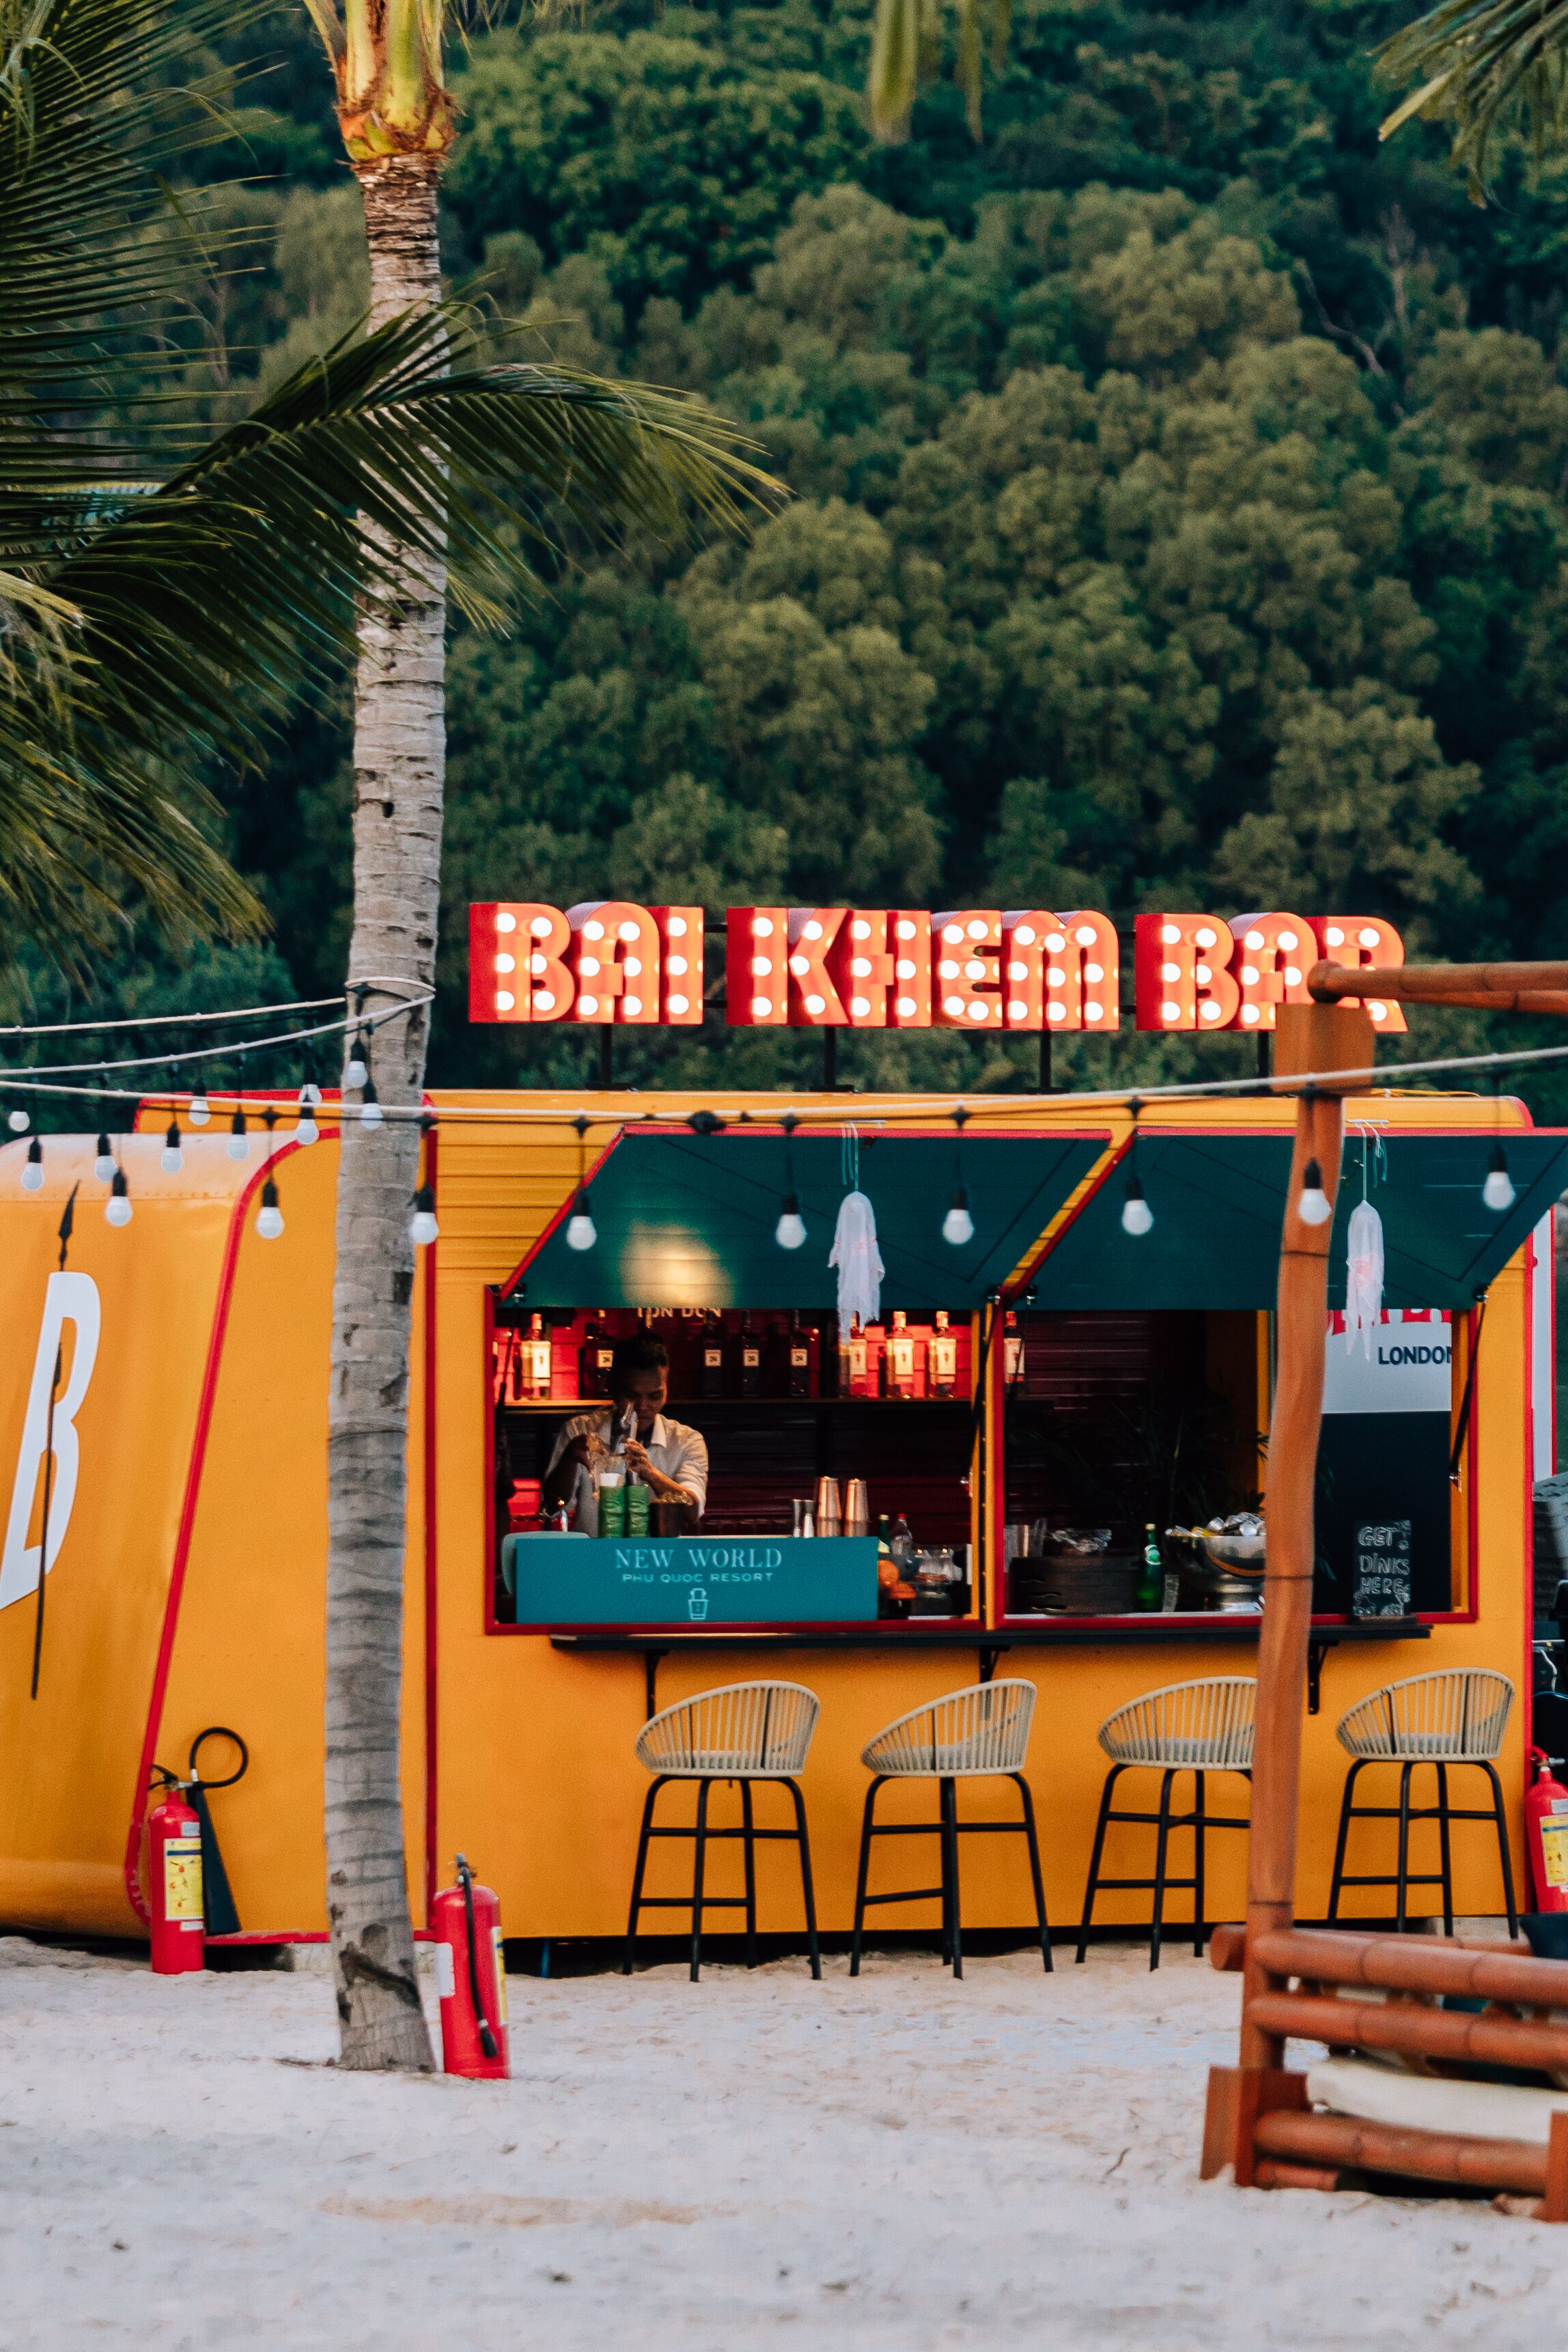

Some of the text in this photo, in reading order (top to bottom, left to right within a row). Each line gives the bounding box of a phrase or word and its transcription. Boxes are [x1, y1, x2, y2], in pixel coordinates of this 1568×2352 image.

[468, 901, 1409, 1033] BAI KHEM BAR
[1358, 1526, 1397, 1547] GET
[615, 1548, 783, 1569] NEW WORLD
[622, 1572, 774, 1583] PHU QUOC RESORT
[1360, 1576, 1405, 1595] HERE
